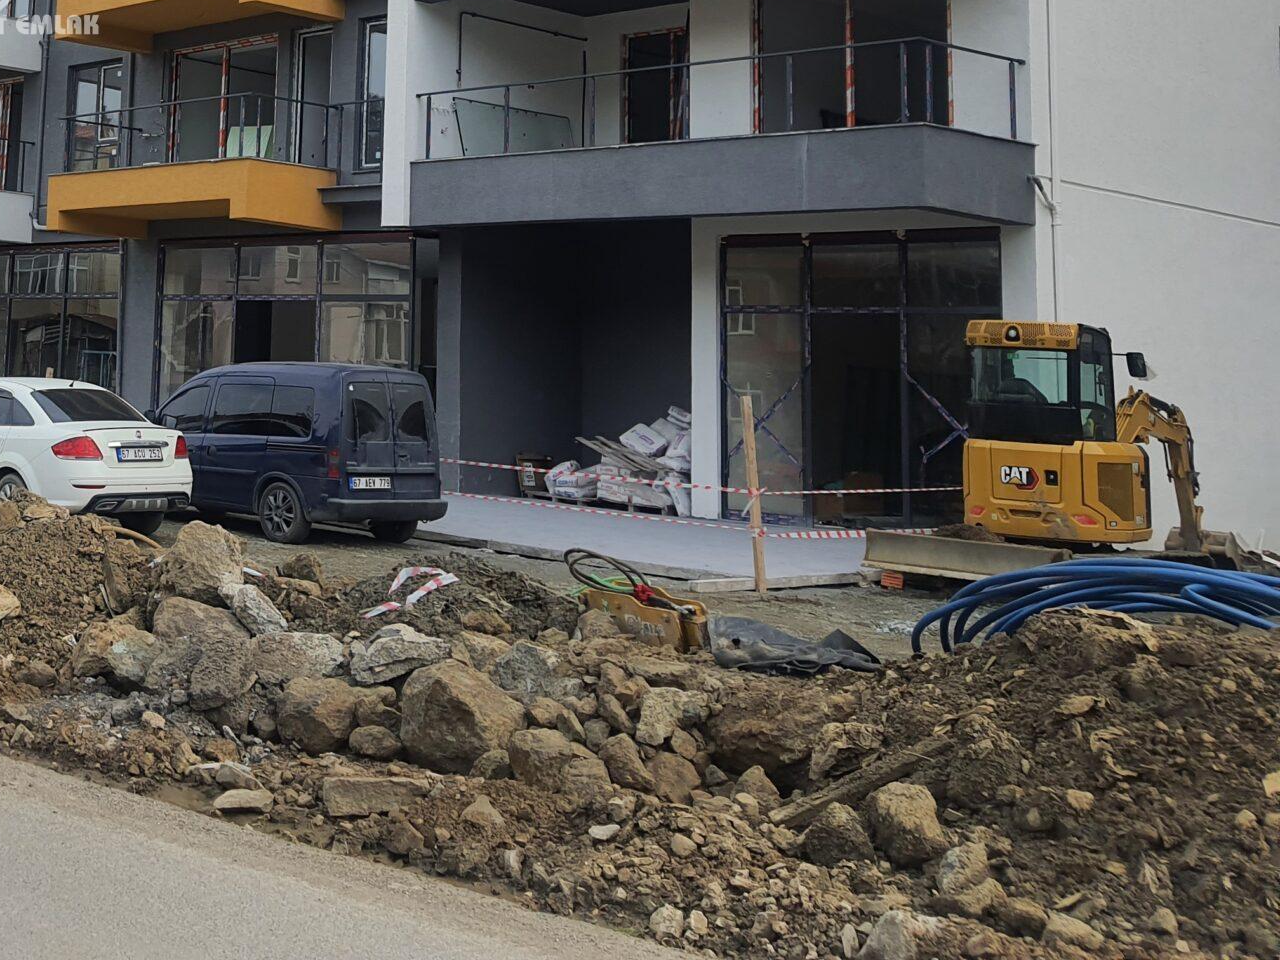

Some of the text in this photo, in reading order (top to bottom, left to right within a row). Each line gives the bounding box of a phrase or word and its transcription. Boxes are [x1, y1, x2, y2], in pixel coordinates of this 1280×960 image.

[353, 478, 361, 487] 67
[379, 478, 390, 487] 779
[1001, 466, 1030, 485] CAT
